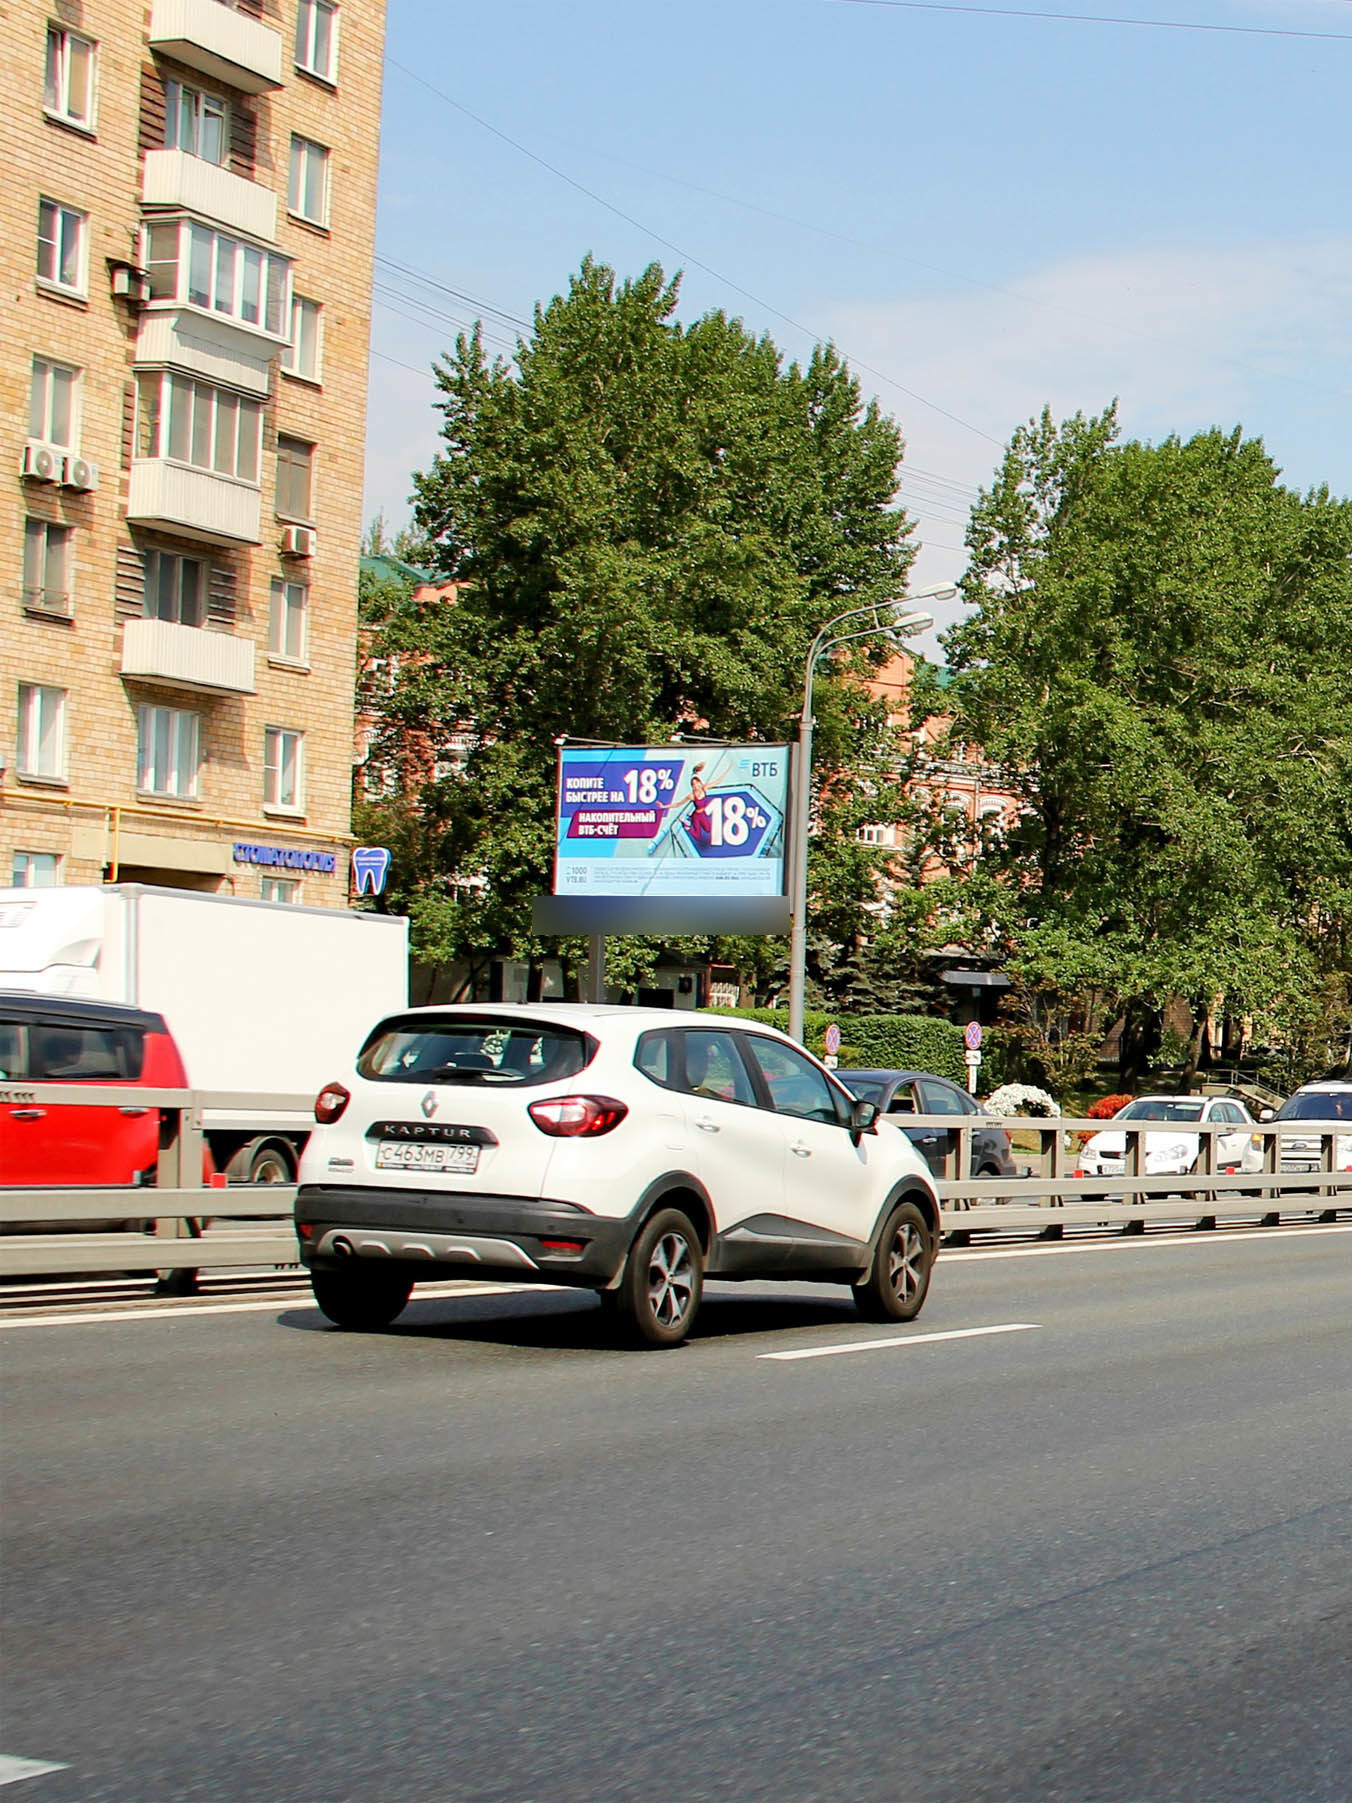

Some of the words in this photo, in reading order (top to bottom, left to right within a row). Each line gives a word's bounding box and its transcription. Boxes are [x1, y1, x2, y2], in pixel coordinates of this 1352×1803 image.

[752, 762, 778, 777] ВТБ
[566, 777, 604, 789] КОПИТЕ
[566, 791, 609, 803] БЫСТРЕЕ
[610, 791, 625, 802] НА
[623, 768, 674, 804] 18%
[578, 810, 656, 823] НАКОПИТЕЛЬНЫЙ
[703, 796, 767, 847] 18%
[384, 1125, 471, 1138] KAPTUR
